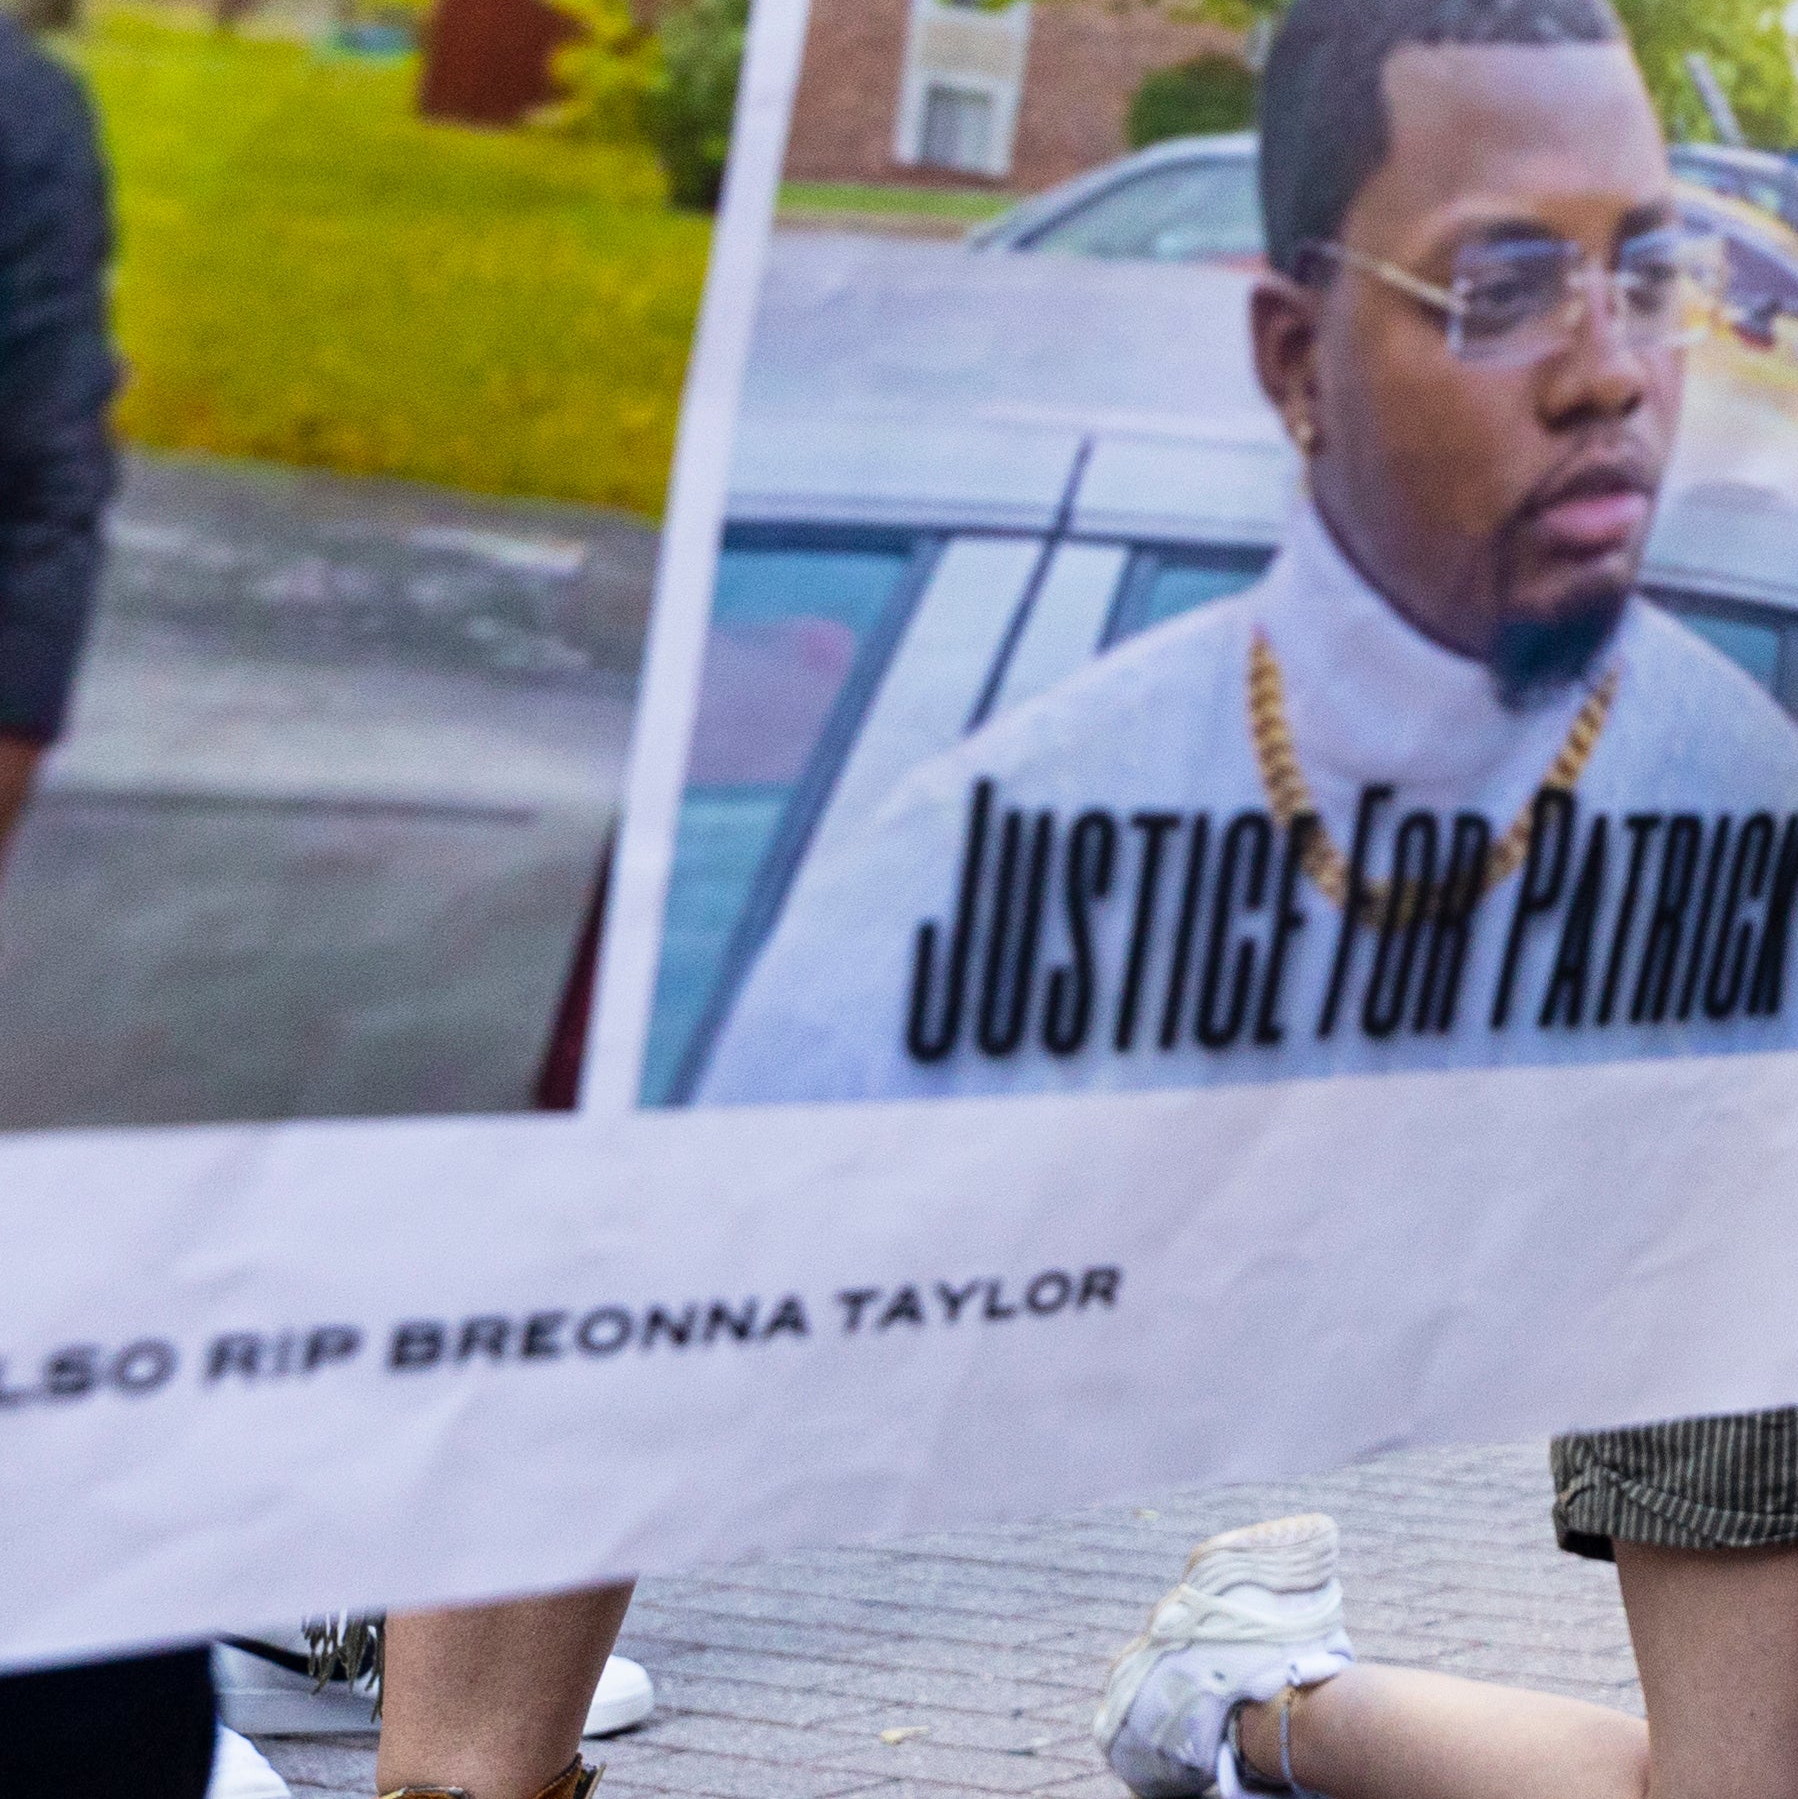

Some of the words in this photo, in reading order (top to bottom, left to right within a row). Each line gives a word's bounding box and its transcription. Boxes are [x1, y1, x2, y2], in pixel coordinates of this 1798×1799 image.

[906, 776, 1314, 1063] JUSTICE
[201, 1324, 366, 1386] RIP
[384, 1292, 810, 1374] BREONNA
[833, 1264, 1125, 1337] TAYLOR
